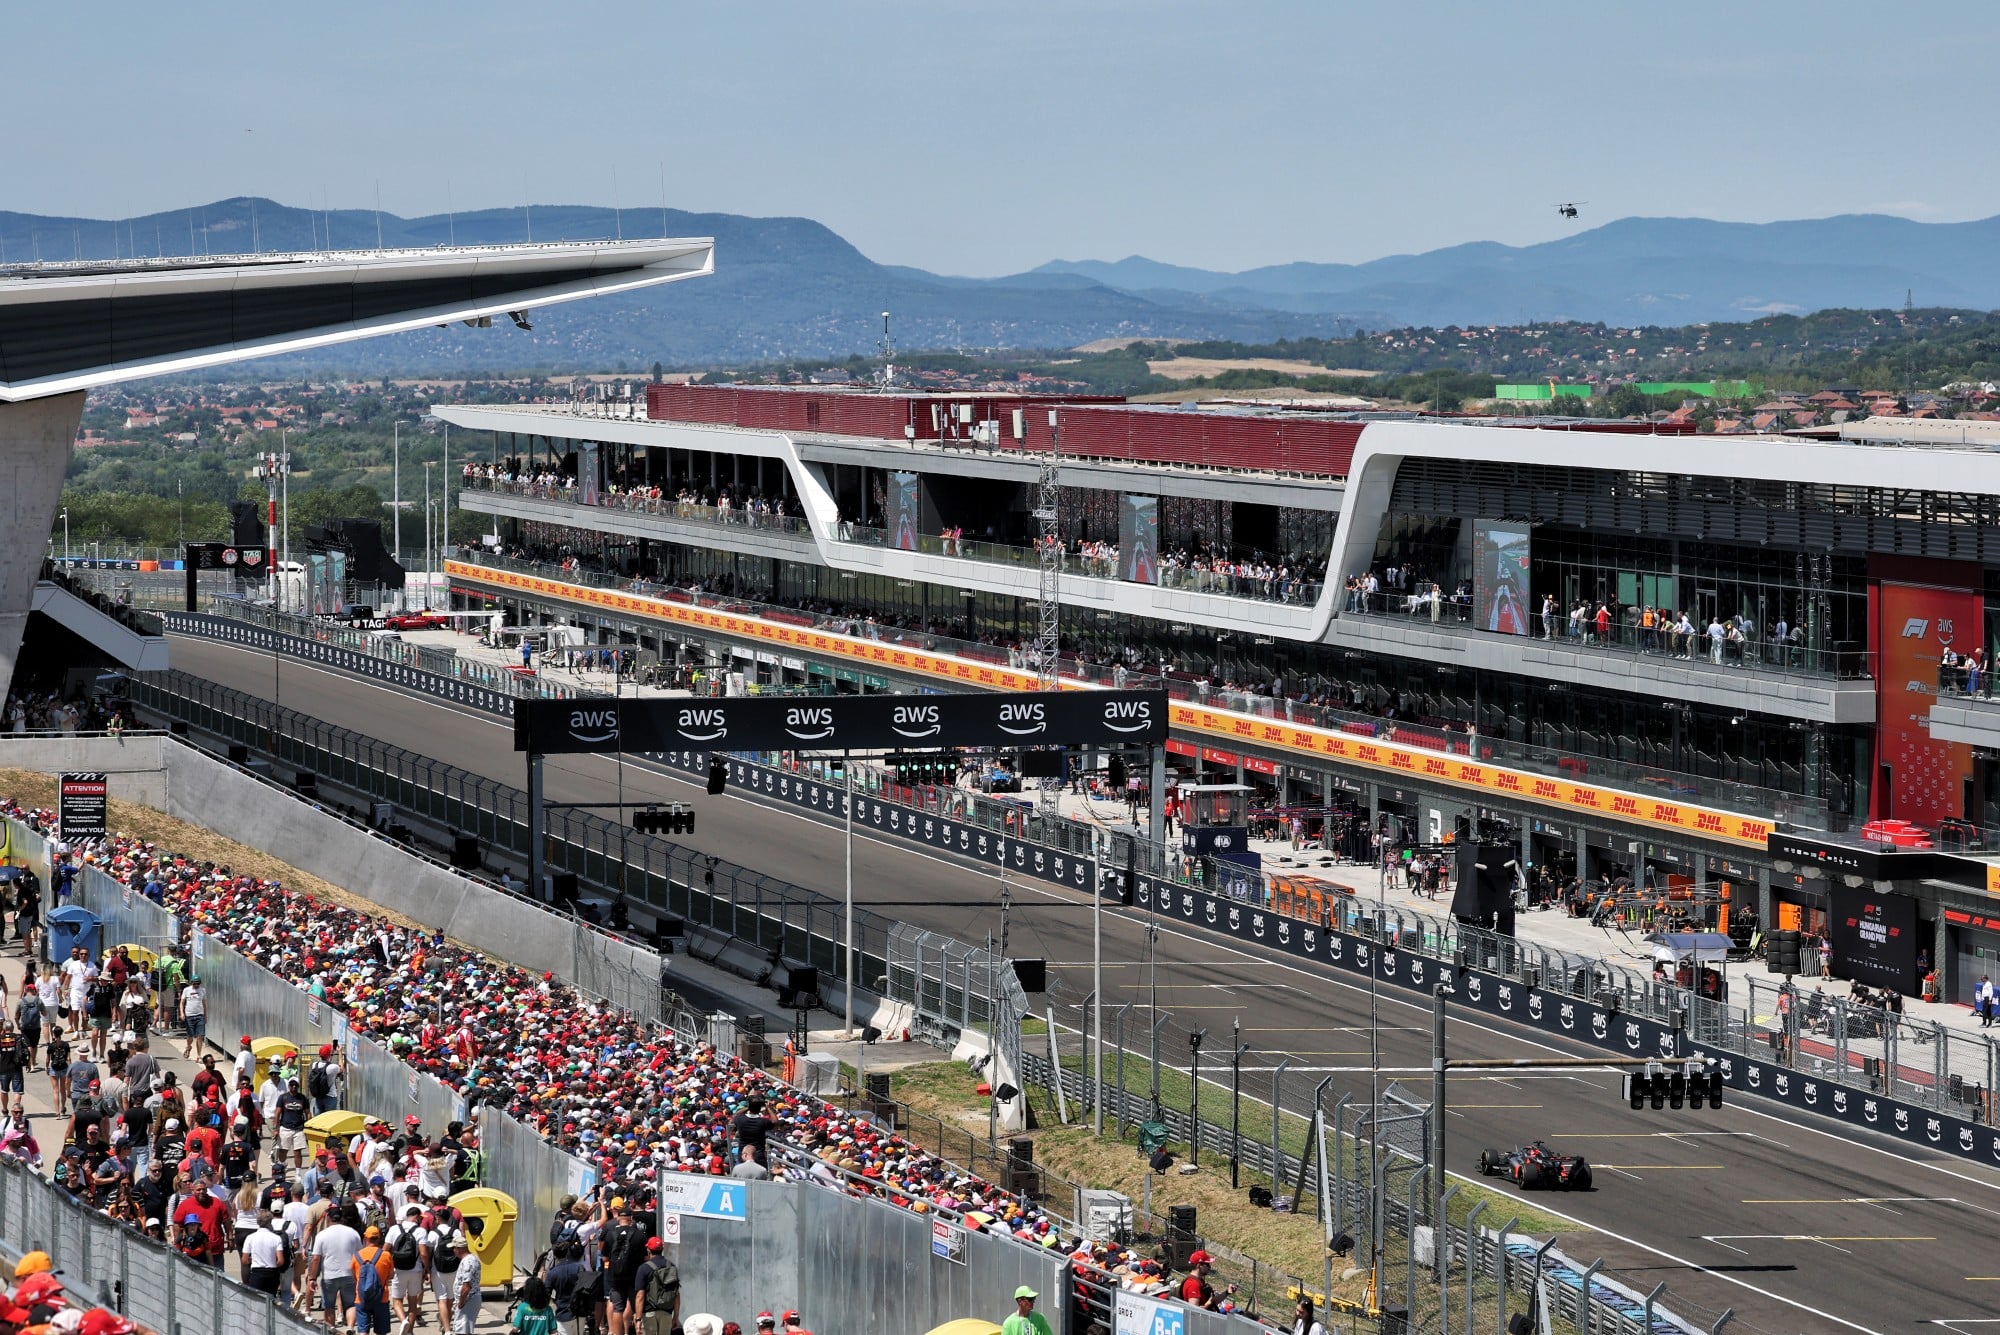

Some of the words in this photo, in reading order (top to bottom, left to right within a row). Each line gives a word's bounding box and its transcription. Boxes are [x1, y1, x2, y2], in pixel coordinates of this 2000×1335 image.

[1938, 618, 1953, 634] aws
[571, 711, 616, 728] aws
[678, 709, 725, 726] aws
[786, 708, 832, 725] aws
[894, 706, 939, 724] aws
[1000, 703, 1044, 721] aws
[1104, 701, 1150, 719] aws
[1178, 710, 1195, 724] DHL
[1234, 720, 1253, 736] DHL
[1264, 726, 1282, 742] DHL
[1294, 732, 1314, 748] DHL
[1325, 739, 1346, 755] DHL
[1357, 745, 1378, 762] DHL
[1390, 752, 1412, 769] DHL
[1424, 759, 1447, 776] DHL
[1459, 766, 1483, 784] DHL
[1496, 773, 1520, 791] DHL
[1533, 780, 1557, 799] DHL
[1572, 788, 1597, 808] DHL
[1612, 796, 1638, 816] DHL
[1653, 804, 1680, 824] DHL
[1695, 813, 1723, 833] DHL
[1740, 822, 1767, 841] DHL
[1859, 920, 1886, 934] HUNGARIAN
[1860, 930, 1875, 941] GRAND
[1876, 932, 1886, 943] PRIX
[1161, 888, 1170, 900] aws
[1183, 894, 1193, 907] aws
[1206, 901, 1216, 914] aws
[1230, 908, 1239, 921] aws
[1253, 914, 1264, 928] aws
[1279, 921, 1289, 935] aws
[1304, 929, 1314, 942] aws
[1331, 936, 1341, 950] aws
[1357, 944, 1367, 958] aws
[1384, 952, 1395, 966] aws
[1412, 960, 1423, 974] aws
[1440, 968, 1452, 983] aws
[1469, 976, 1481, 991] aws
[1499, 985, 1511, 1000] aws
[1530, 994, 1542, 1009] aws
[1561, 1003, 1573, 1019] aws
[1593, 1012, 1606, 1029] aws
[1626, 1022, 1640, 1038] aws
[1660, 1032, 1674, 1049] aws
[1720, 1058, 1732, 1071] aws
[1748, 1066, 1760, 1079] aws
[1776, 1074, 1788, 1087] aws
[1805, 1082, 1816, 1096] aws
[1834, 1090, 1846, 1104] aws
[1865, 1100, 1877, 1113] aws
[1896, 1108, 1908, 1122] aws
[1928, 1118, 1940, 1132] aws
[1960, 1127, 1973, 1142] aws
[720, 1192, 733, 1212] A
[1118, 1307, 1129, 1317] GRID
